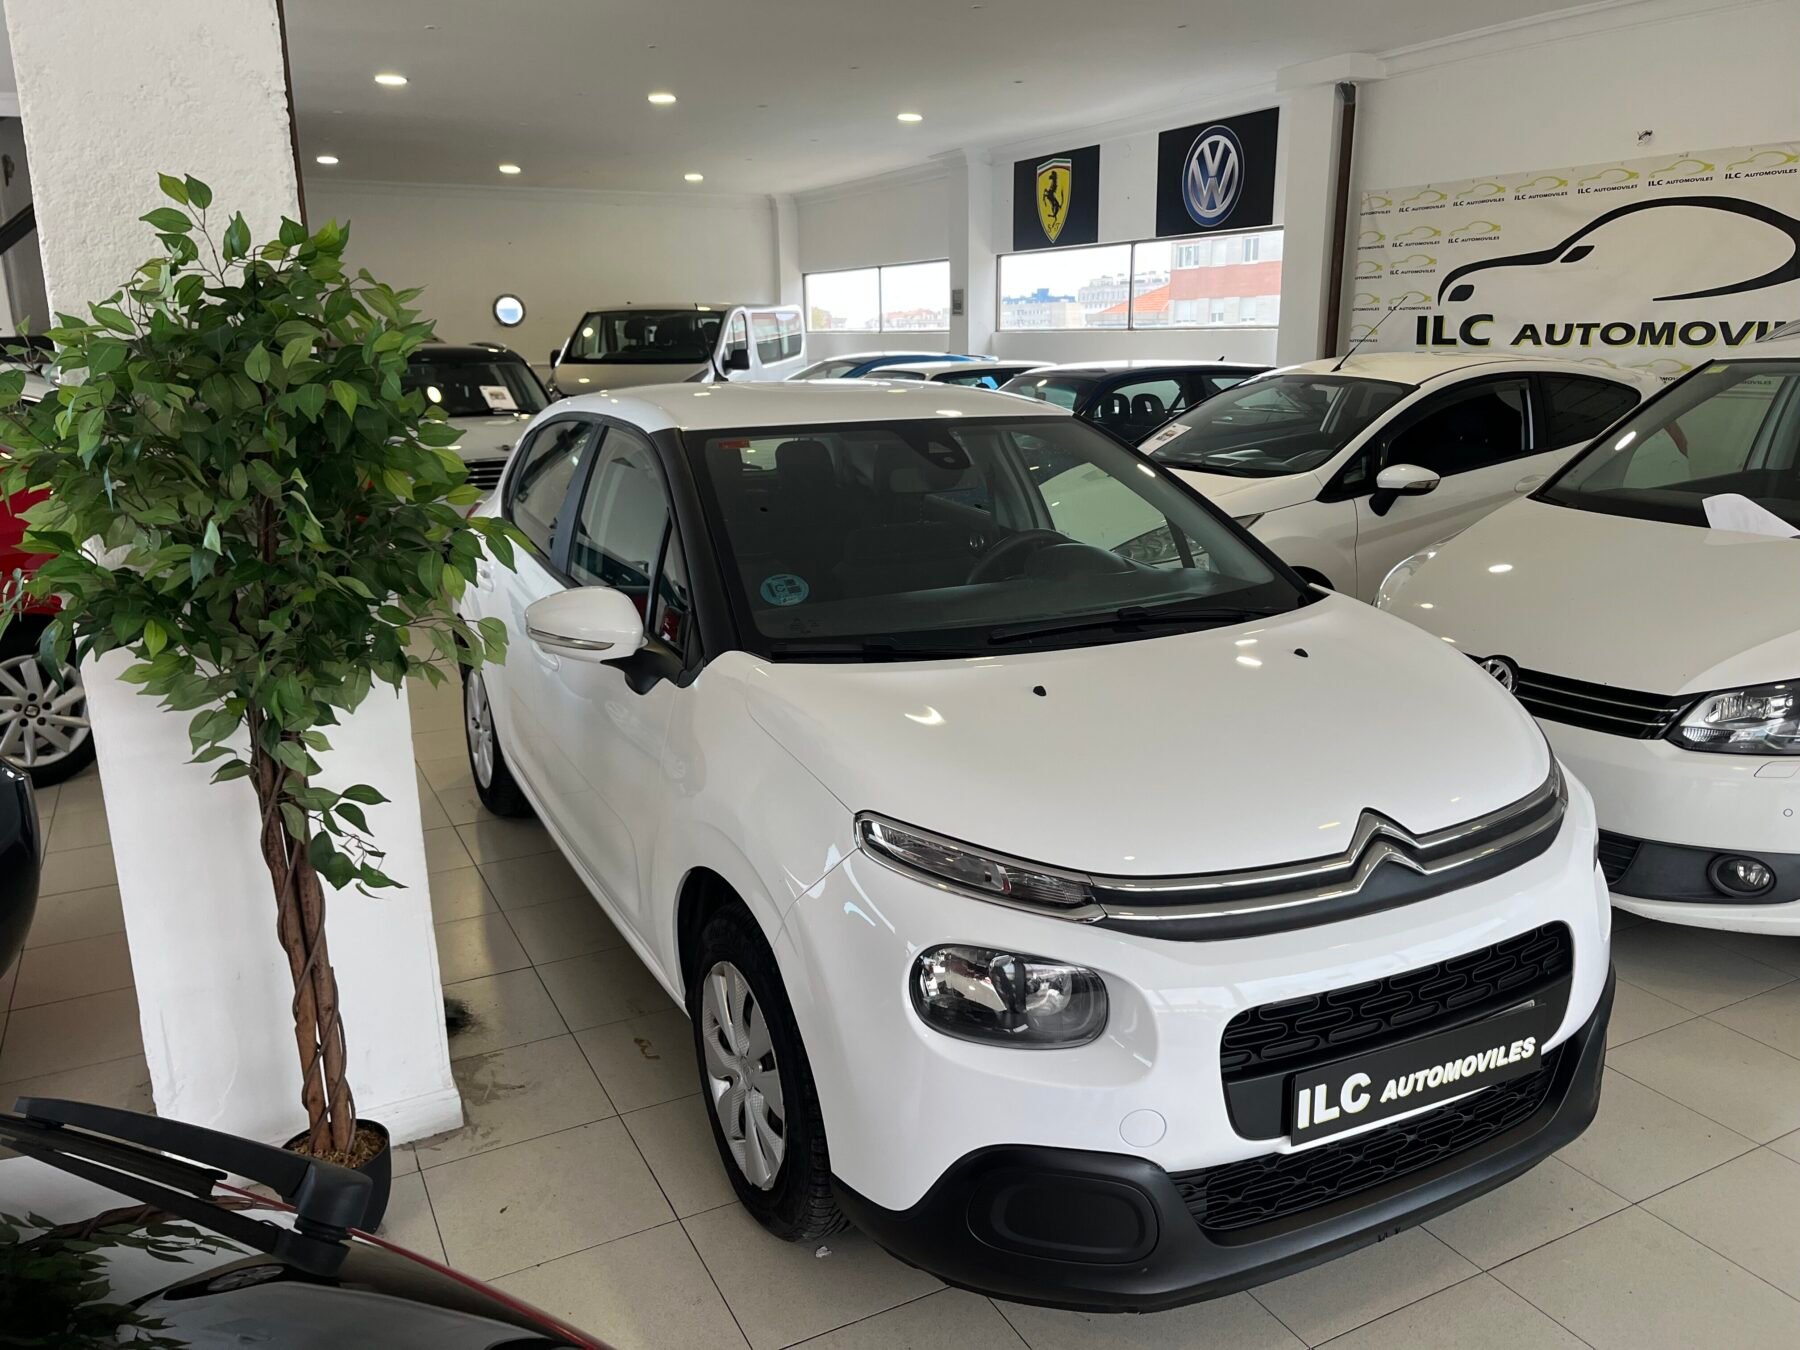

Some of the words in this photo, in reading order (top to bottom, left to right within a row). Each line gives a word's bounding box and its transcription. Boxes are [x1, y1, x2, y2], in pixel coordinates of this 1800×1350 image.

[1724, 172, 1742, 180] ILC
[1744, 168, 1798, 178] AUTOMOVILES
[1648, 179, 1663, 187] ILC
[1665, 176, 1713, 185] AUTOMOVILES
[1593, 184, 1638, 193] AUTOMOVILES
[1528, 191, 1568, 200] AUTOMOVILES
[1466, 197, 1505, 206] AUTOMOVILES
[1460, 235, 1500, 243] AUTOMOVILES
[1416, 313, 1494, 347] ILC
[1297, 1071, 1372, 1130] ILC
[1379, 1036, 1537, 1103] AUTOMOVILES
